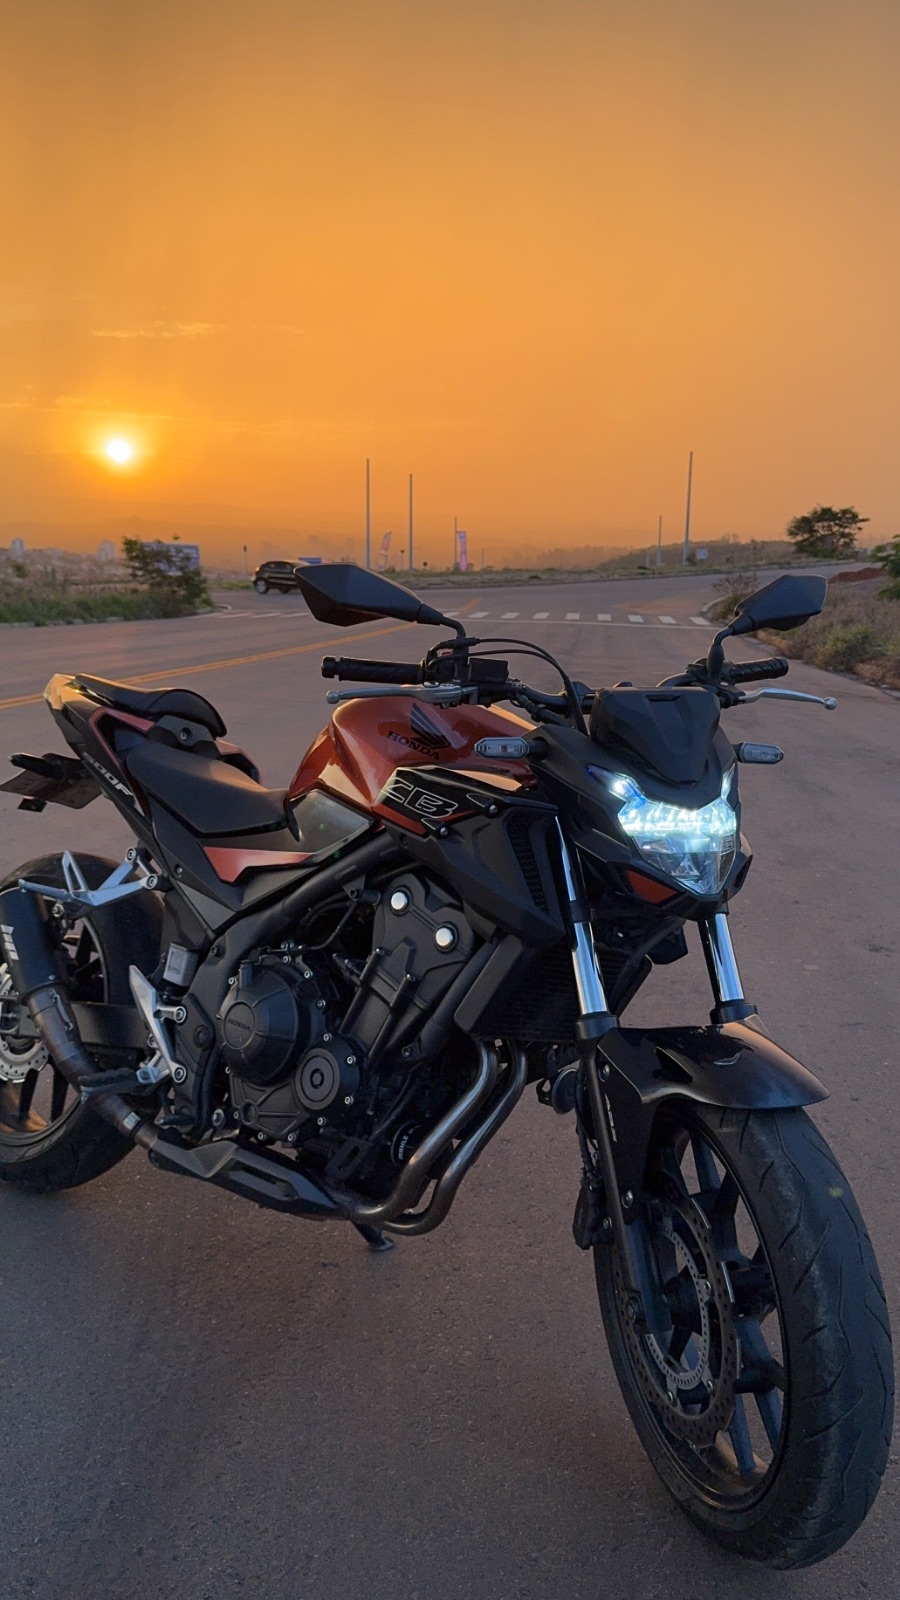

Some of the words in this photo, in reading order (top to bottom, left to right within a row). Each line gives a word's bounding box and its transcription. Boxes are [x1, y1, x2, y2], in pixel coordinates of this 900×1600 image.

[387, 730, 440, 760] HONDA
[380, 777, 459, 819] CB
[228, 1018, 251, 1031] HONDA
